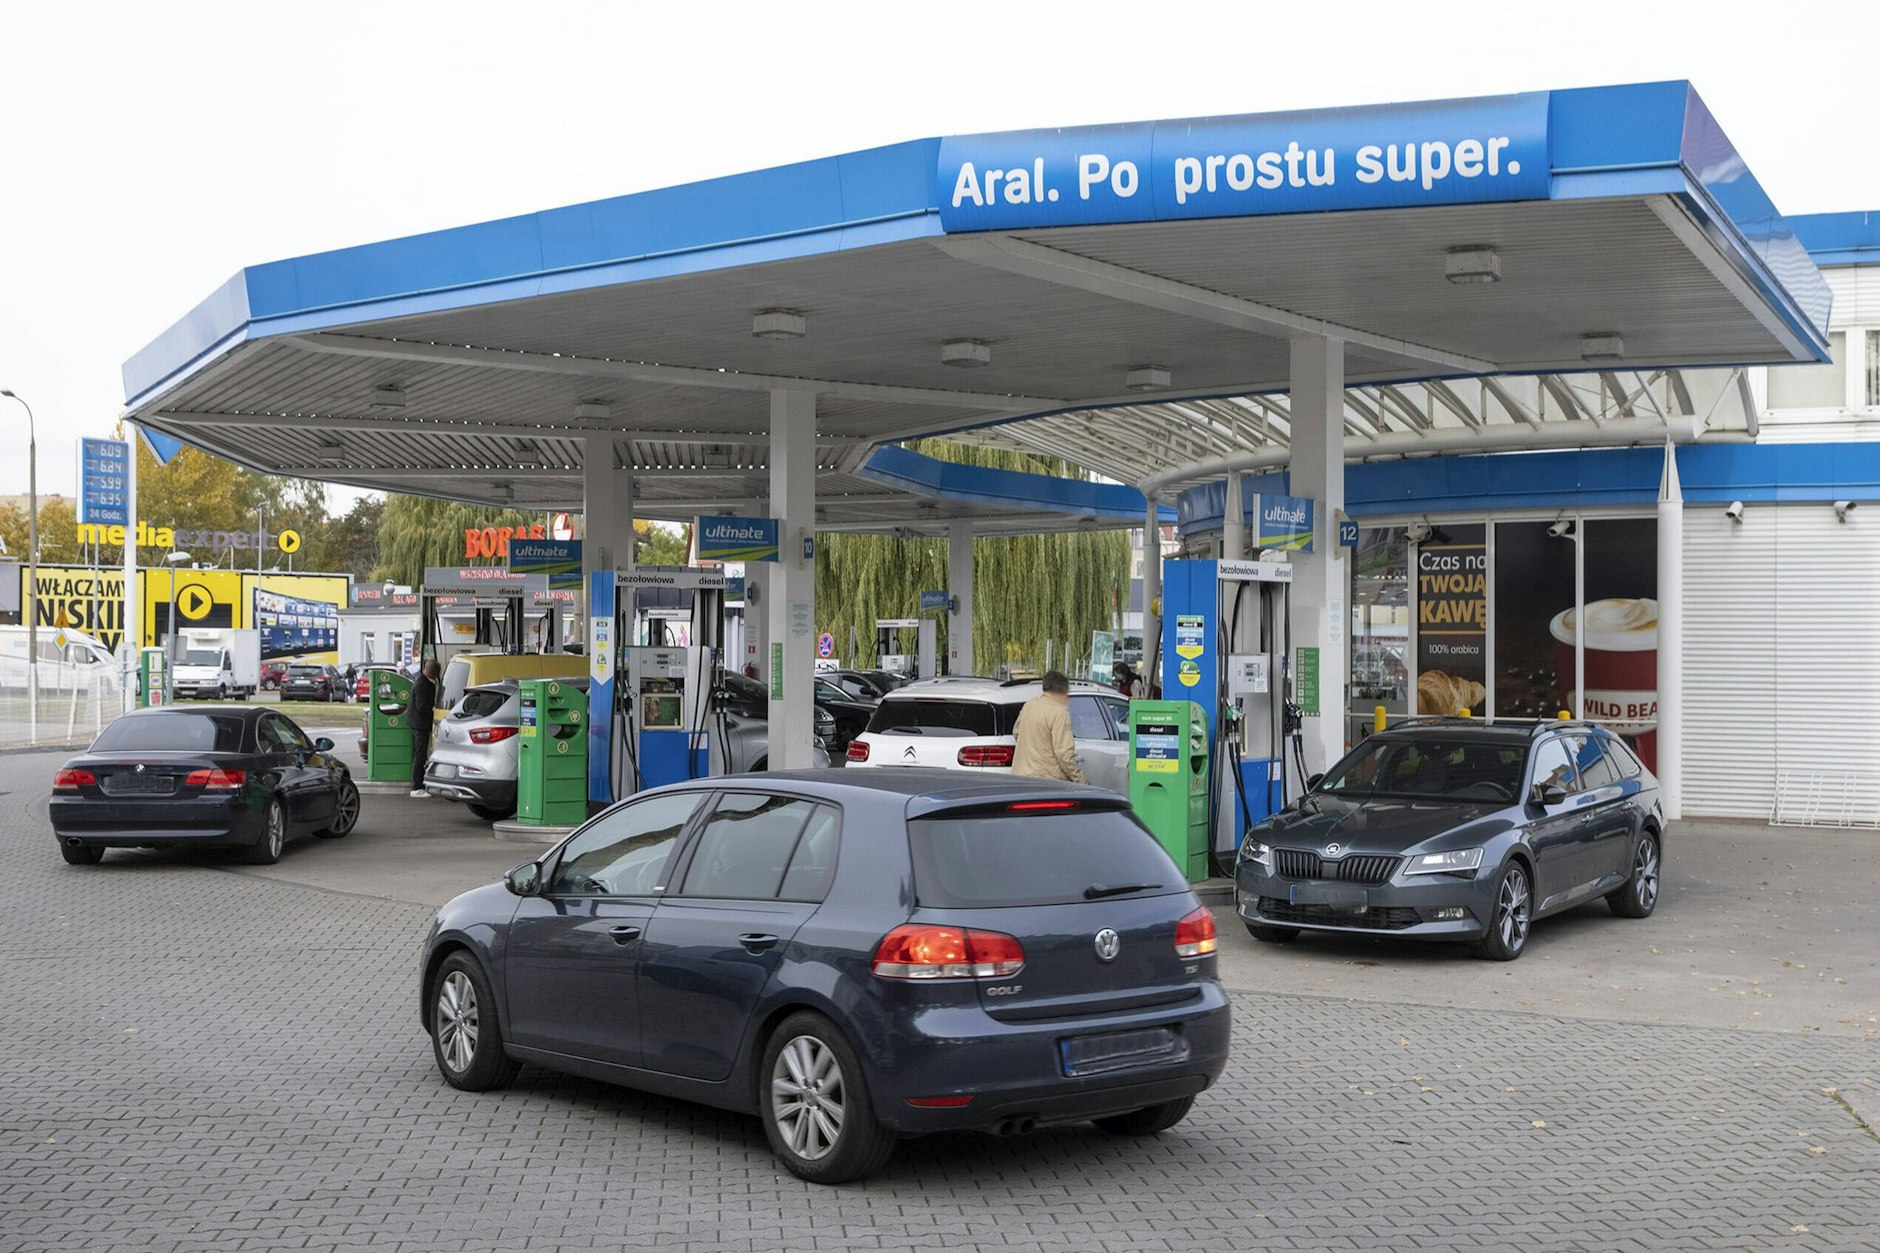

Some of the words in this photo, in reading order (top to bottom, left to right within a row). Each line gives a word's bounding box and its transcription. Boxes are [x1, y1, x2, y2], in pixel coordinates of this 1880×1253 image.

[951, 156, 1060, 207] Aral.
[1078, 154, 1139, 199] Po
[1174, 141, 1336, 204] prostu
[1355, 136, 1521, 190] super.
[89, 508, 101, 519] 24
[1264, 506, 1306, 523] ultimate
[706, 525, 764, 540] ultimate
[1340, 525, 1358, 541] 12
[515, 545, 568, 558] ultimate
[804, 541, 813, 555] 10
[1420, 552, 1460, 571] Czas
[1220, 564, 1259, 576] bezołowiowa
[1274, 567, 1292, 578] diesel
[617, 573, 675, 585] bezołowiowa
[698, 576, 724, 586] diesel
[1420, 574, 1487, 597] TWOJĄ
[423, 586, 476, 596] bezołowiowa
[498, 588, 523, 597] diesel
[1420, 599, 1487, 630] KAWĘ
[1429, 645, 1449, 654] 100%
[1450, 645, 1479, 655] arabica
[986, 985, 1023, 997] GOLF
